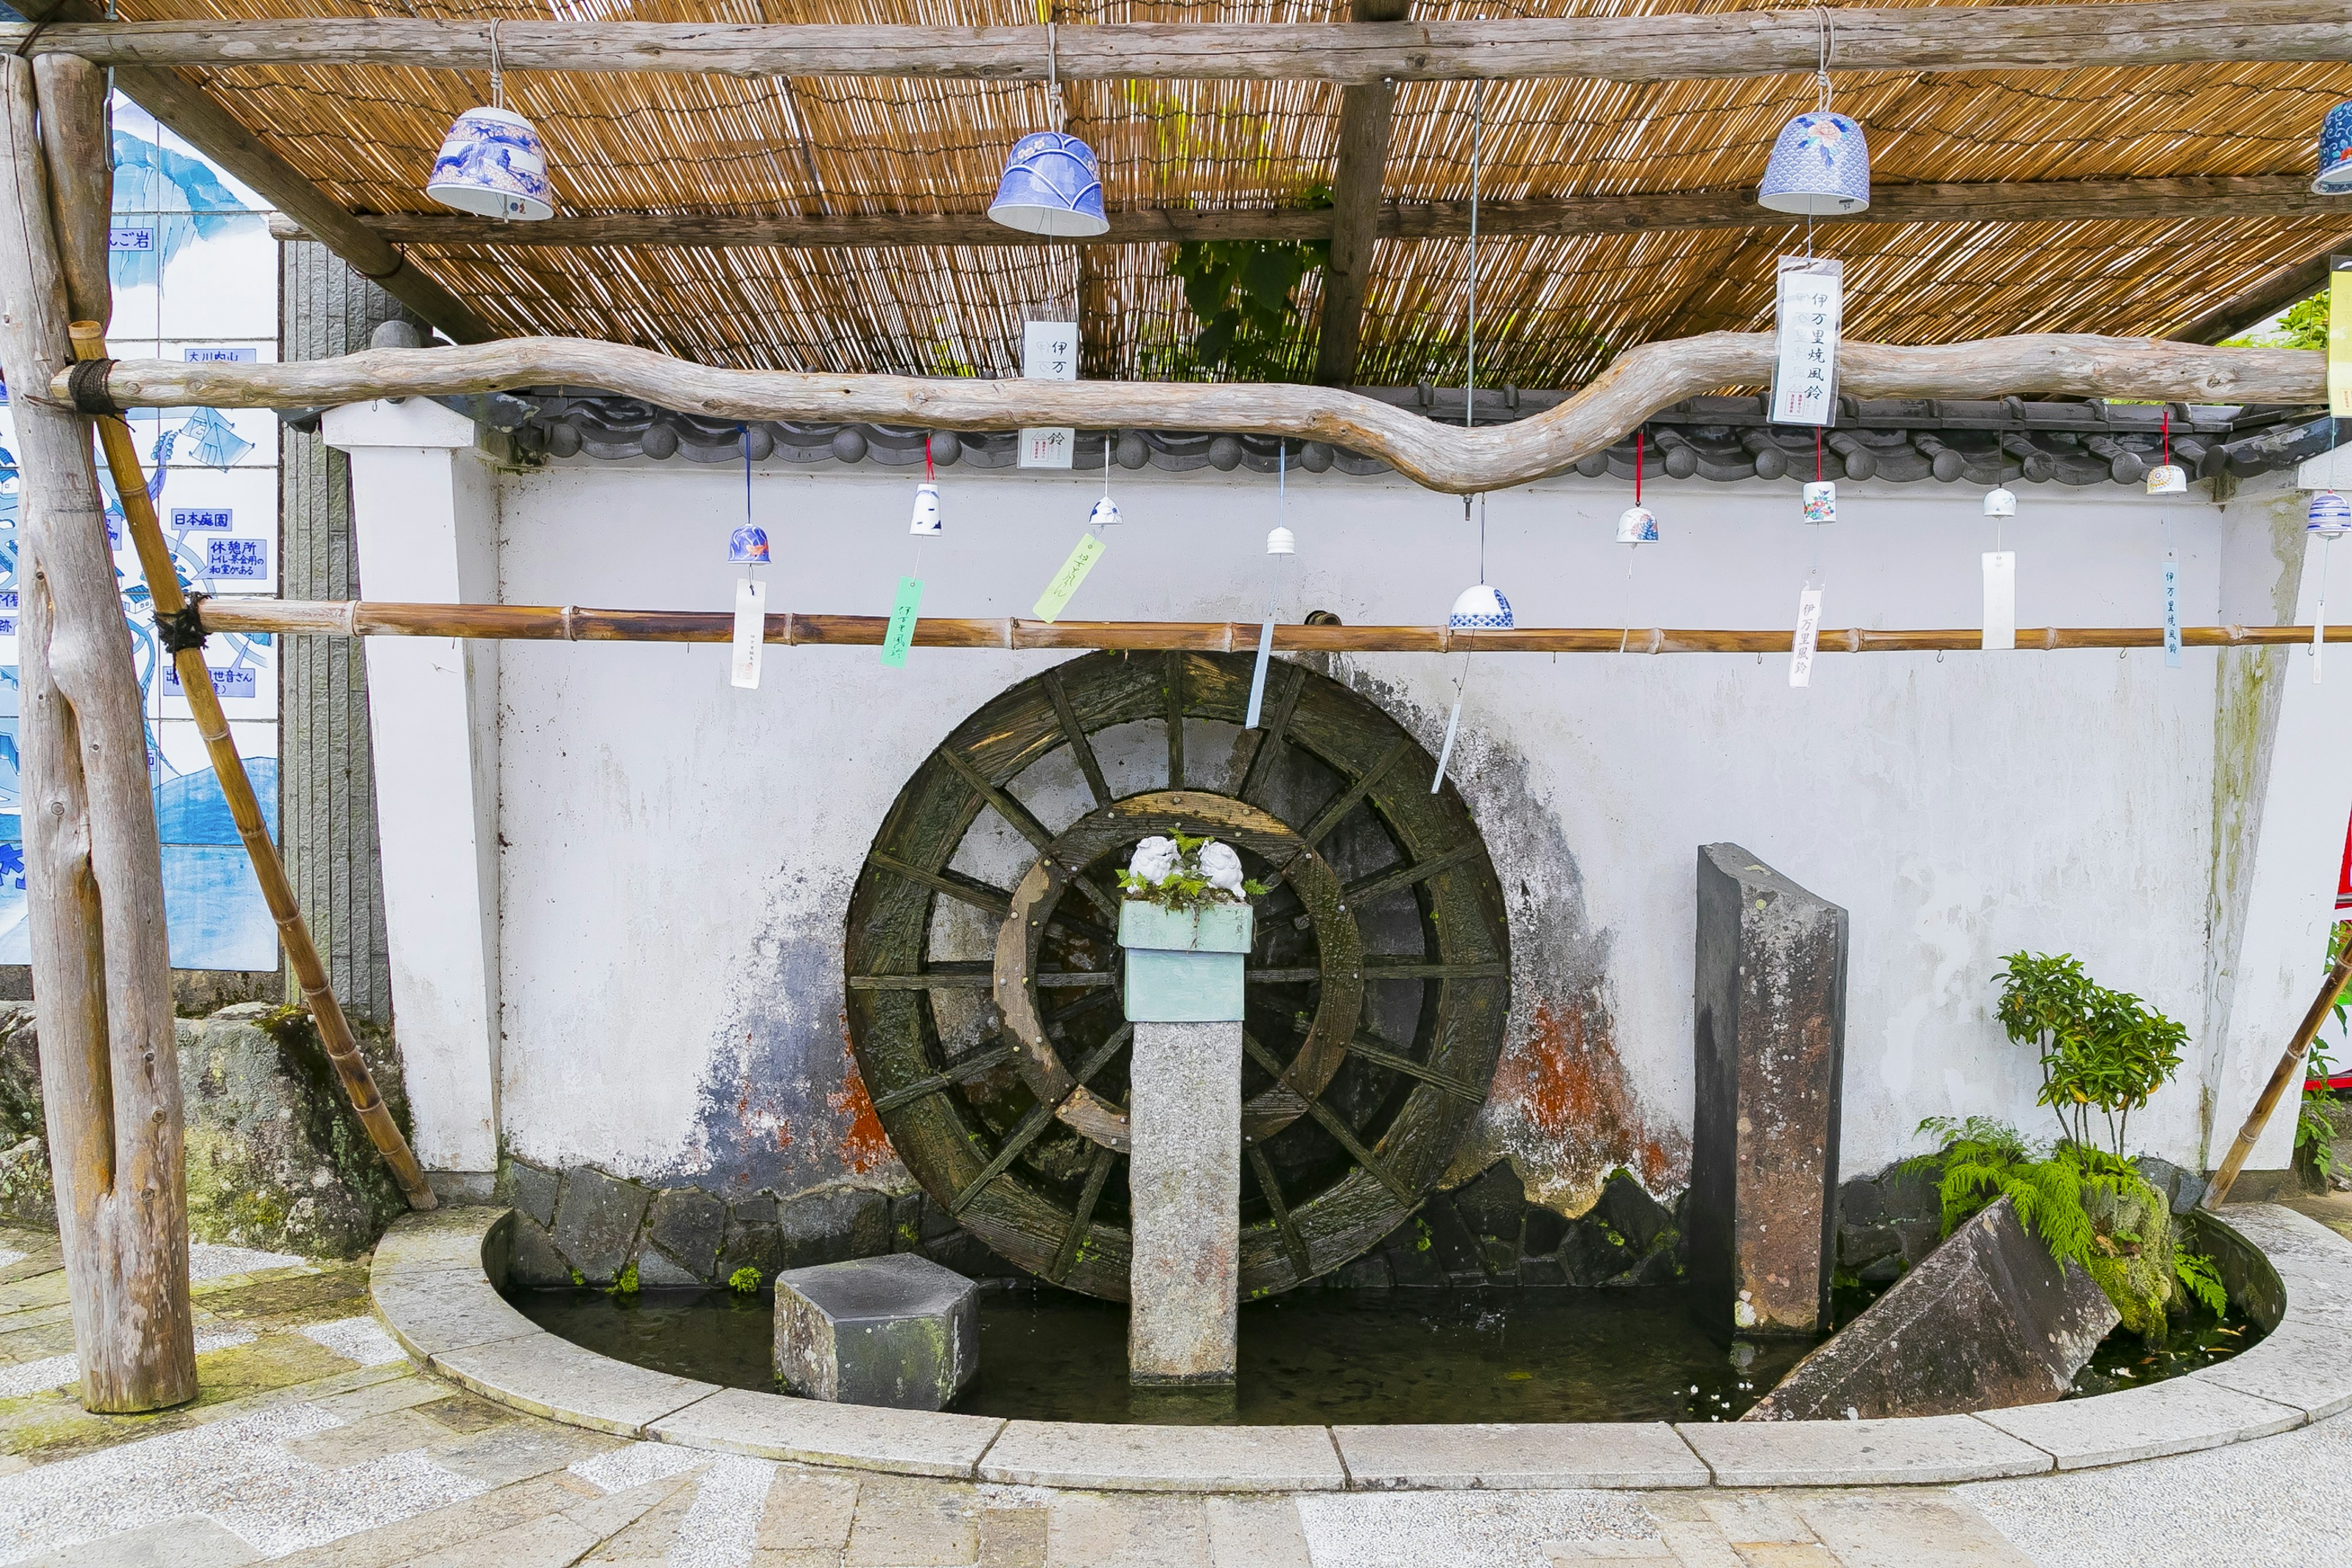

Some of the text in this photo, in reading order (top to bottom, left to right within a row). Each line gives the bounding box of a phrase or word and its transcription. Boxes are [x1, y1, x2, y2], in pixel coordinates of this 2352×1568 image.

[1804, 293, 1828, 400] 伊万里焼風鈴
[189, 350, 238, 362] 大川内山
[175, 512, 228, 527] 日本庭園
[211, 541, 257, 555] 休憩所
[209, 564, 254, 575] 和室がある
[2166, 571, 2177, 654] 伊万里焼風鈴
[1795, 604, 1815, 674] 伊万里風鈴
